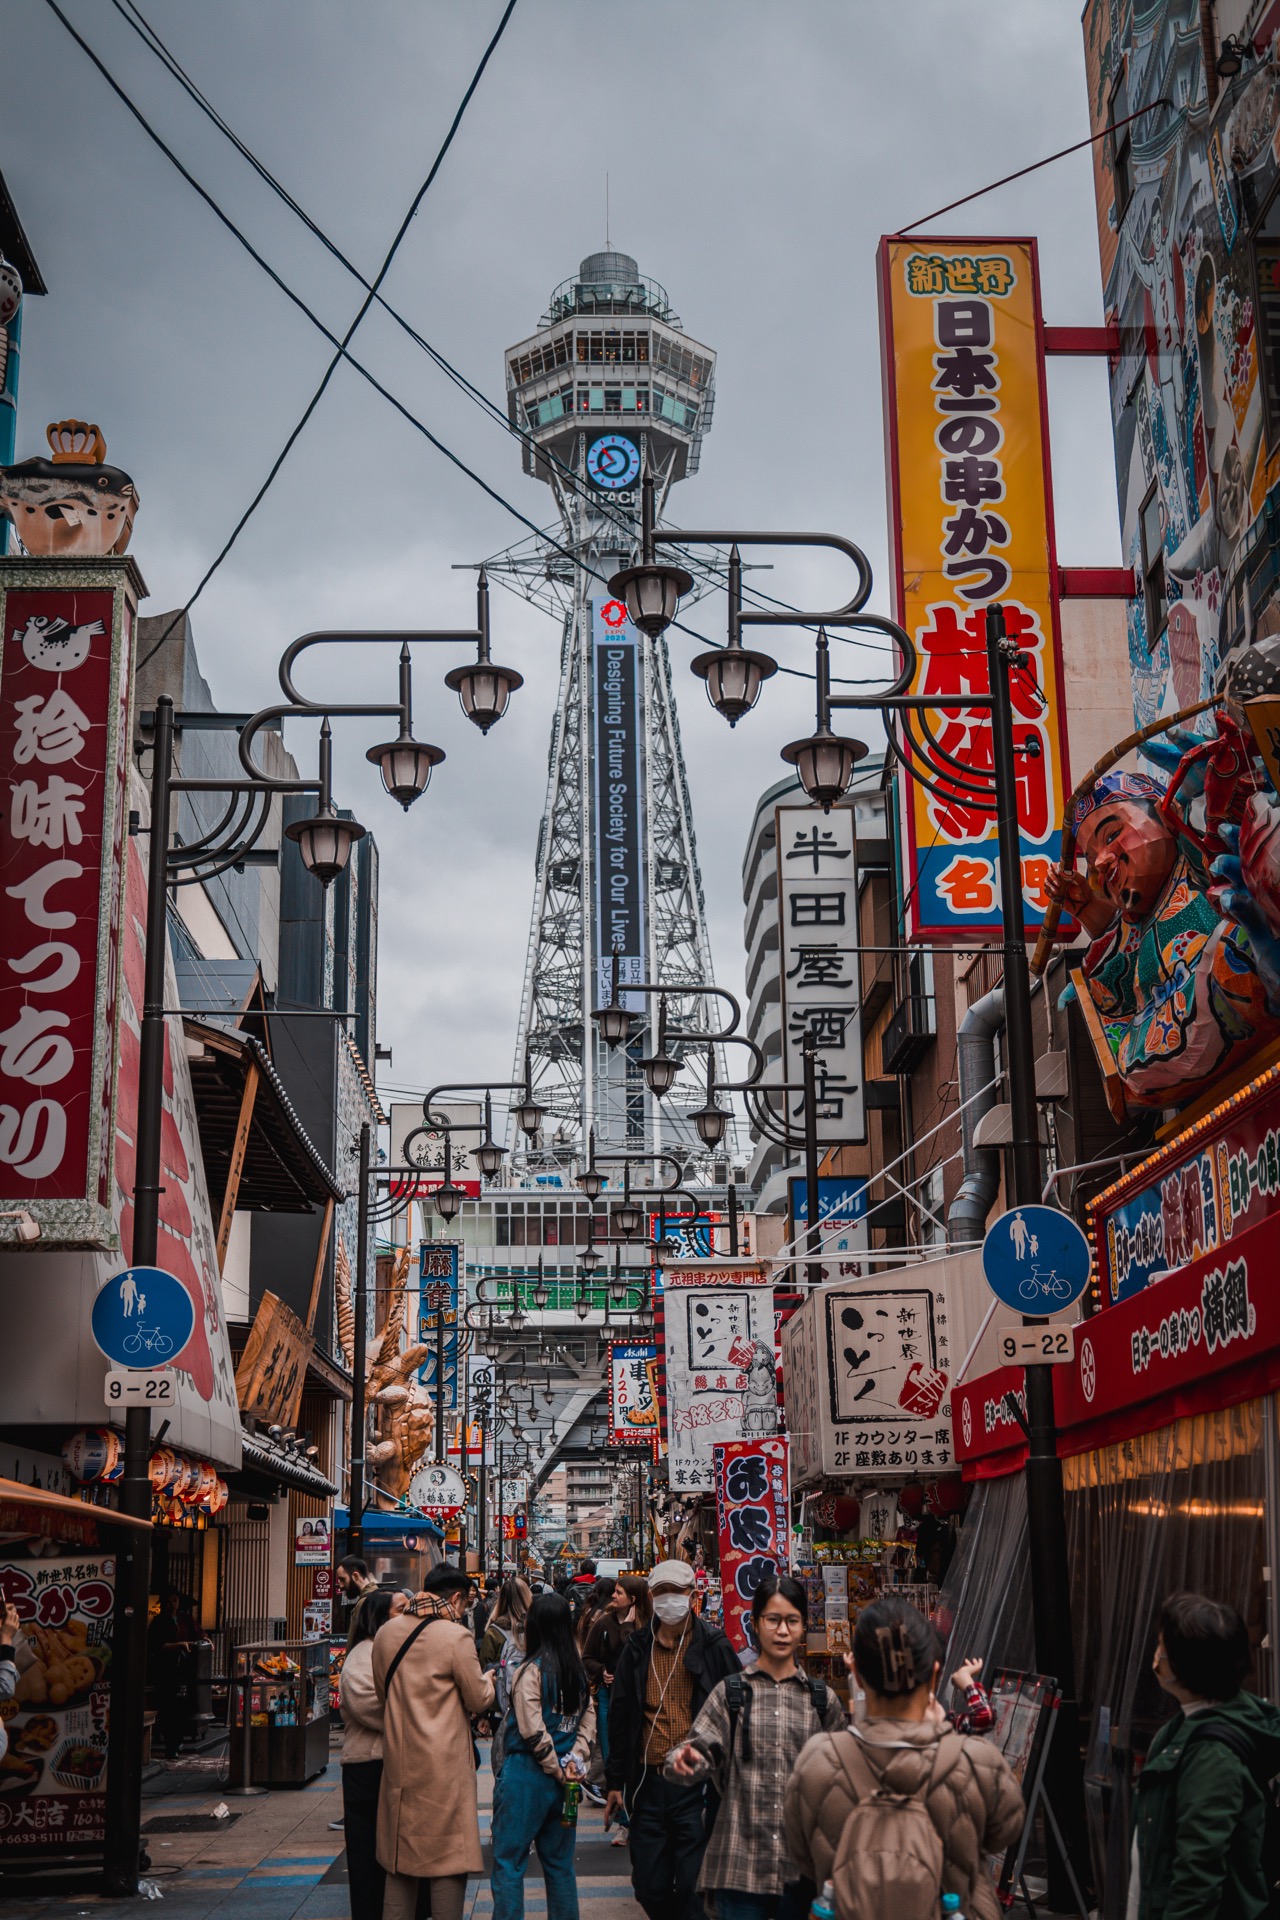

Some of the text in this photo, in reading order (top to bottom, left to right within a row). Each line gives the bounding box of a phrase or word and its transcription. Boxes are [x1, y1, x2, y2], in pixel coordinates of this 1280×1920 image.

[909, 256, 1015, 294] 新世界
[934, 300, 1008, 600] 日本一の串かつ
[579, 490, 641, 505] HITACH
[606, 649, 625, 722] Designing
[609, 728, 625, 777] Future
[607, 780, 627, 841] Society
[611, 847, 627, 867] for
[611, 873, 627, 906] Our
[611, 910, 628, 952] Lives
[786, 826, 857, 1118] 半田屋酒店
[1226, 1129, 1280, 1218] 日本一の串
[1203, 1157, 1217, 1248] 名門
[1116, 1213, 1165, 1282] 日本一の串かつ
[421, 1248, 452, 1310] 麻雀
[669, 1271, 767, 1286] 元祖串カツ専門店
[897, 1307, 922, 1361] 新世界
[936, 1293, 949, 1367] 商標登録
[1131, 1257, 1250, 1374] 日本一の串かつ 横綱
[624, 1348, 648, 1358] Asahi
[629, 1361, 653, 1410] 串カツ
[695, 1375, 749, 1389] 総本店
[834, 1429, 950, 1446] 1F カウンター席
[834, 1450, 951, 1467] 2F 座敷あります
[37, 1564, 98, 1584] 新世界名物
[727, 1455, 775, 1646] おみや
